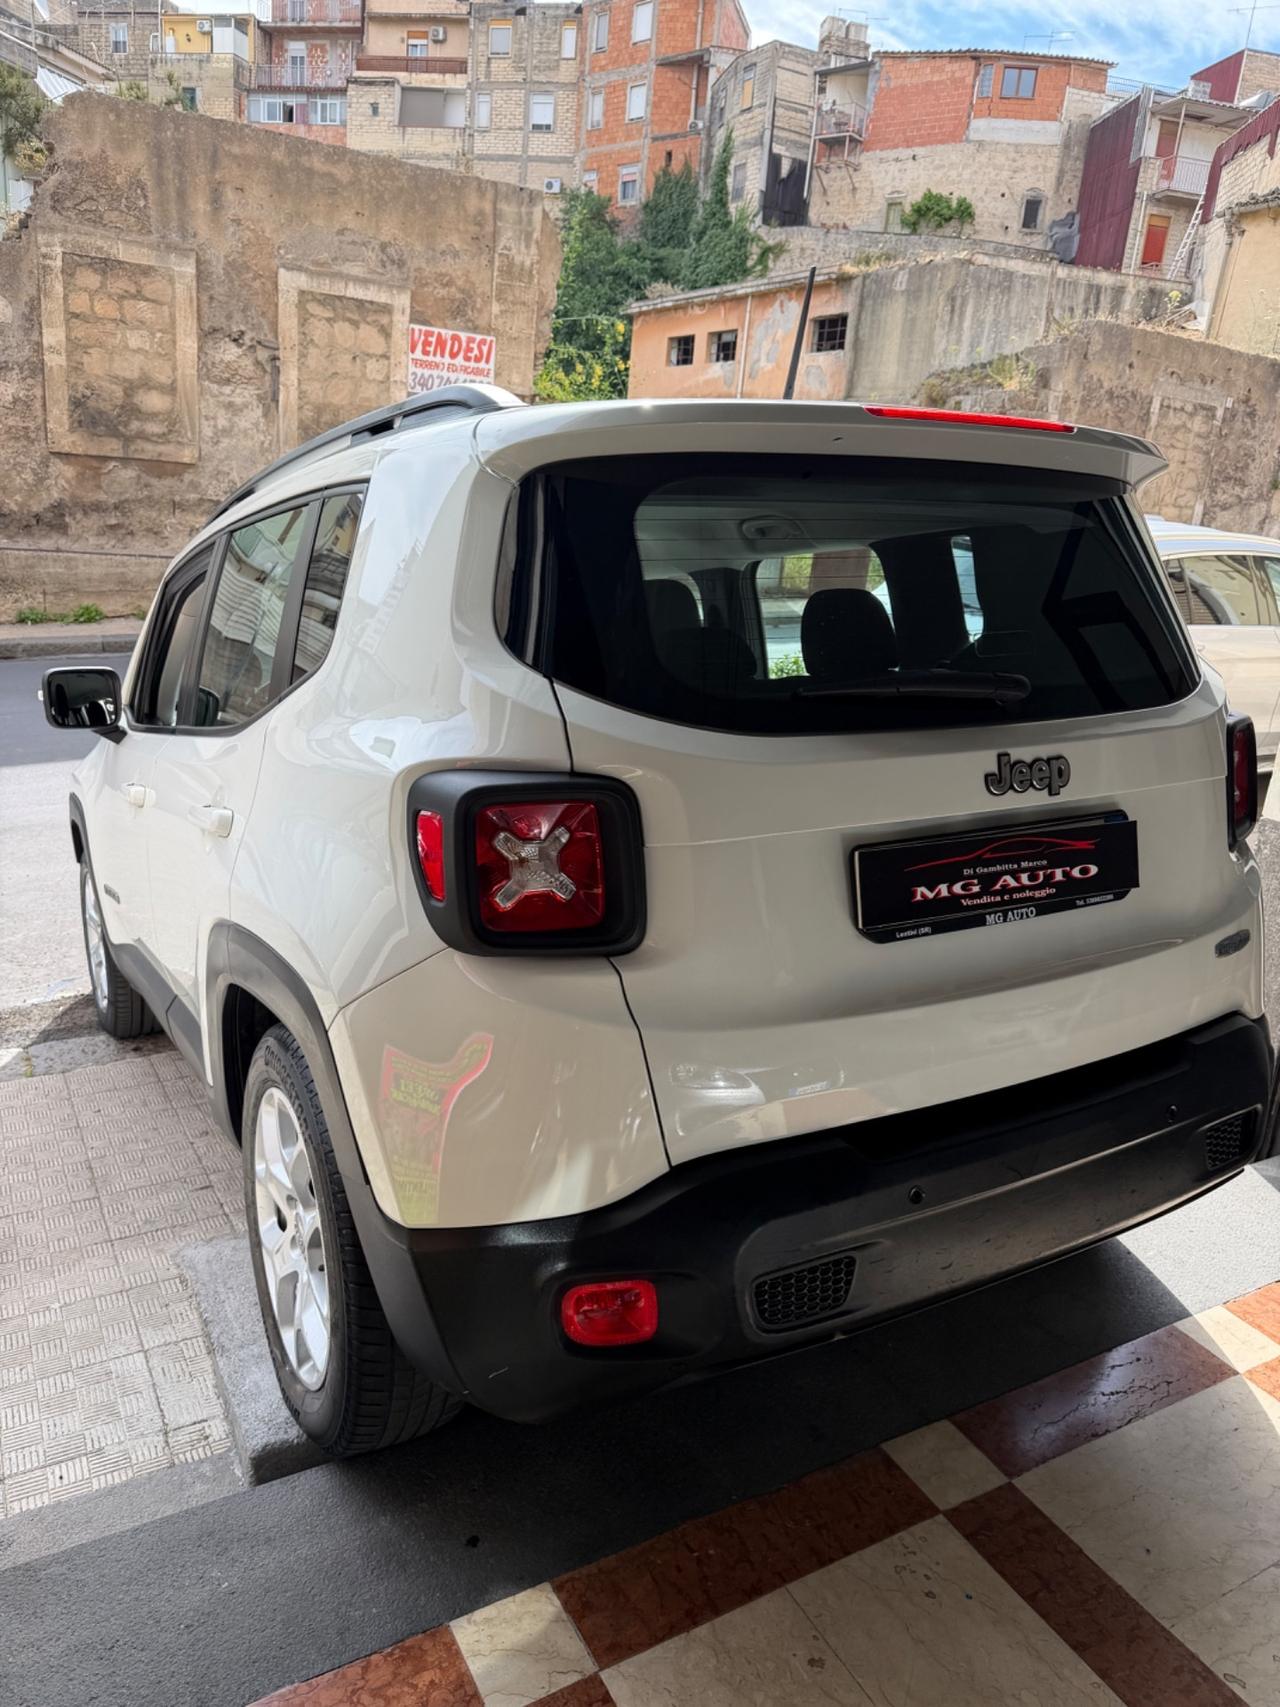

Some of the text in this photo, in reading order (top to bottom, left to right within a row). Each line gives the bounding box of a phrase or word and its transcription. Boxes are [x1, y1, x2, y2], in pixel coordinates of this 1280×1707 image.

[409, 326, 494, 365] VENDESI
[985, 751, 1071, 796] Jeep
[963, 859, 1048, 876] Di Gambitta Marco
[911, 863, 1100, 903] MG AUTO
[960, 886, 1056, 907] Vendita e noleggio
[985, 906, 1036, 925] MG AUTO
